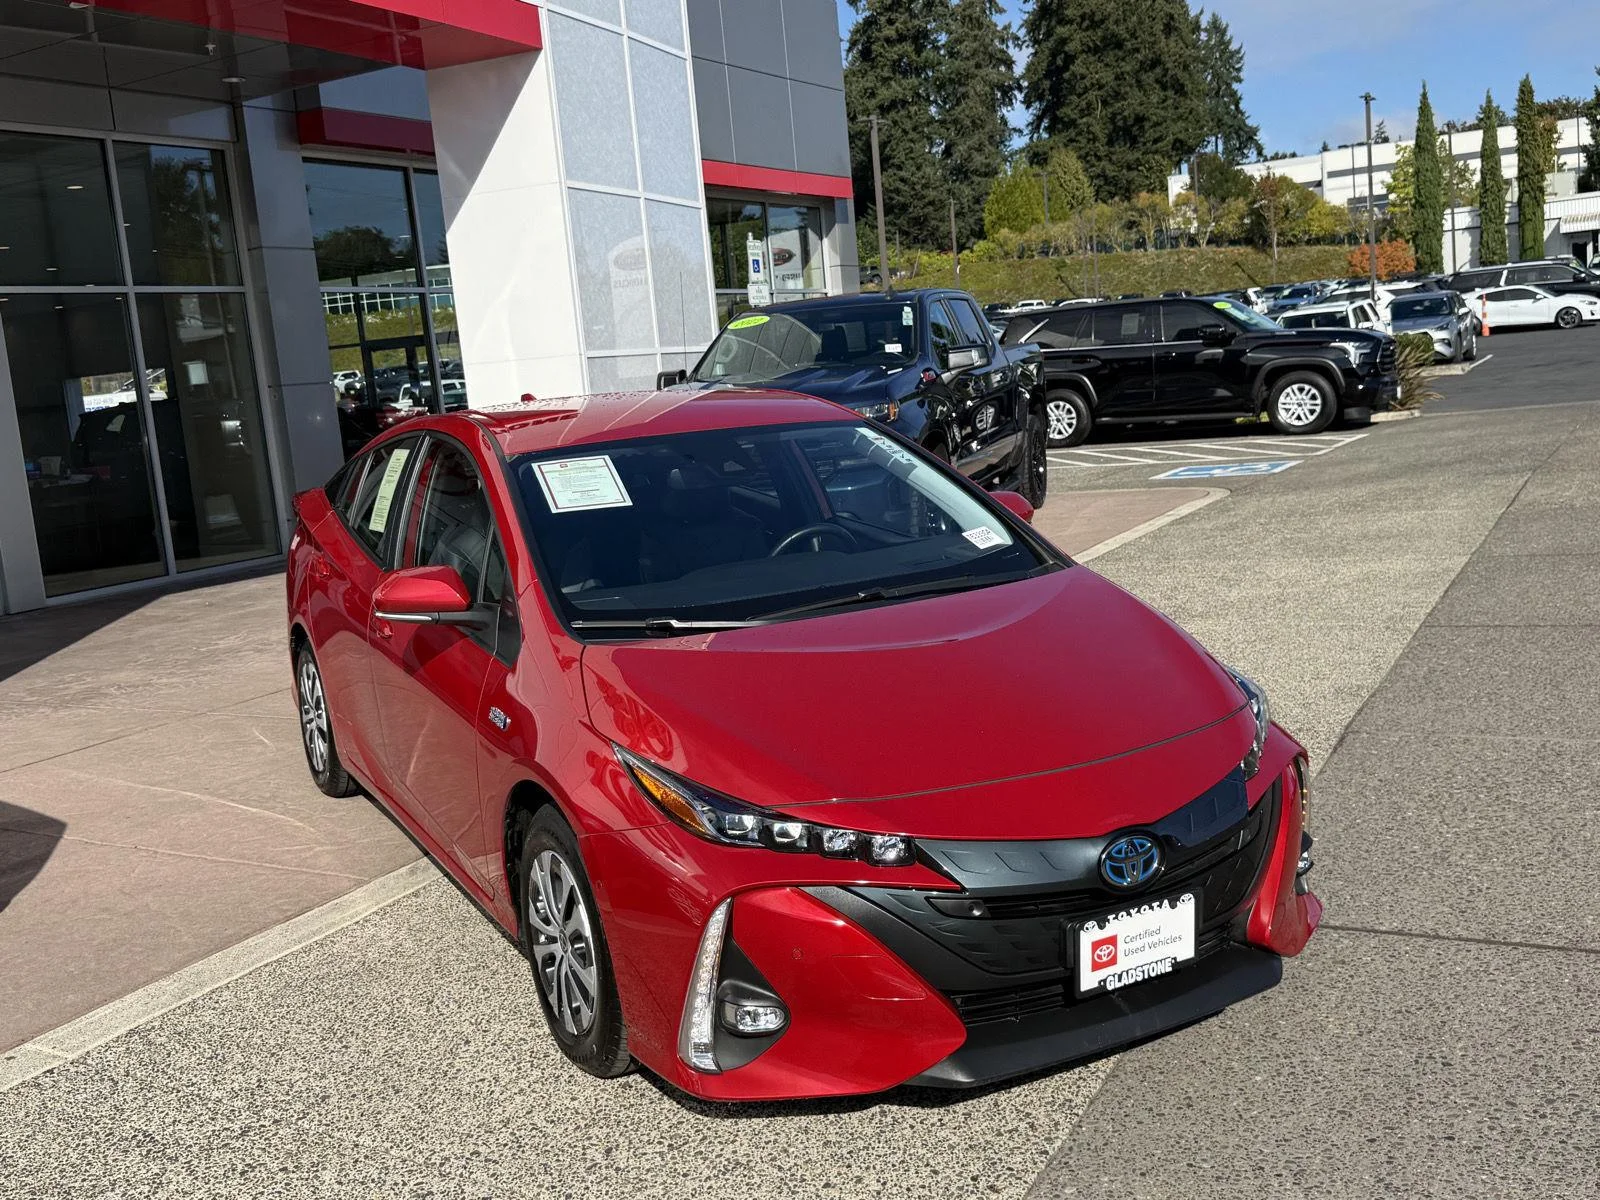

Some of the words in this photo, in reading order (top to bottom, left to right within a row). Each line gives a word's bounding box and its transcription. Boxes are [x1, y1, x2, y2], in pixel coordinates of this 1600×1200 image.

[1107, 899, 1171, 922] TOYOTA
[1123, 926, 1161, 944] Certified
[1123, 944, 1146, 957] Used
[1147, 934, 1182, 951] Vehicles
[1106, 957, 1172, 990] GLADSTONE
